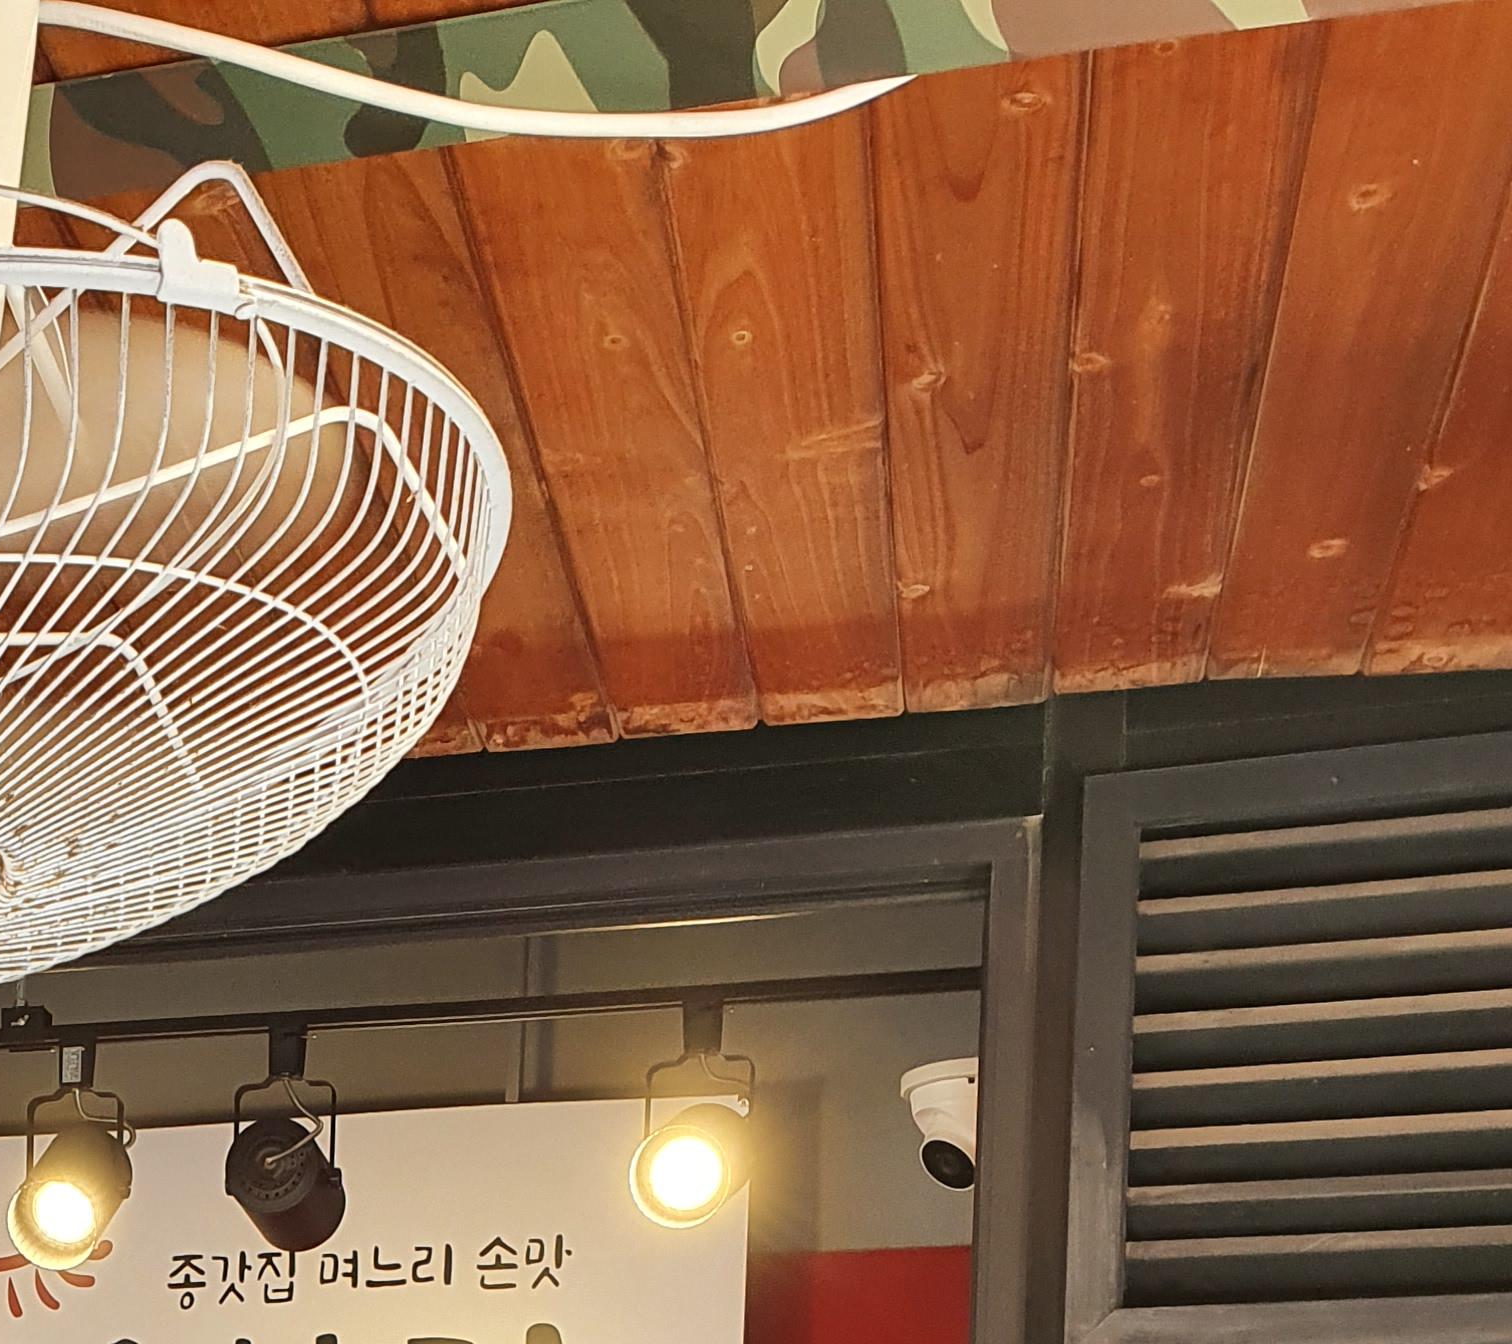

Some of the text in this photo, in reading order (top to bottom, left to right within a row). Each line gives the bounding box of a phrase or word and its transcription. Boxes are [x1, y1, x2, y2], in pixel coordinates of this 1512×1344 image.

[167, 1234, 573, 1310] 종갓집 며느리 손맛
